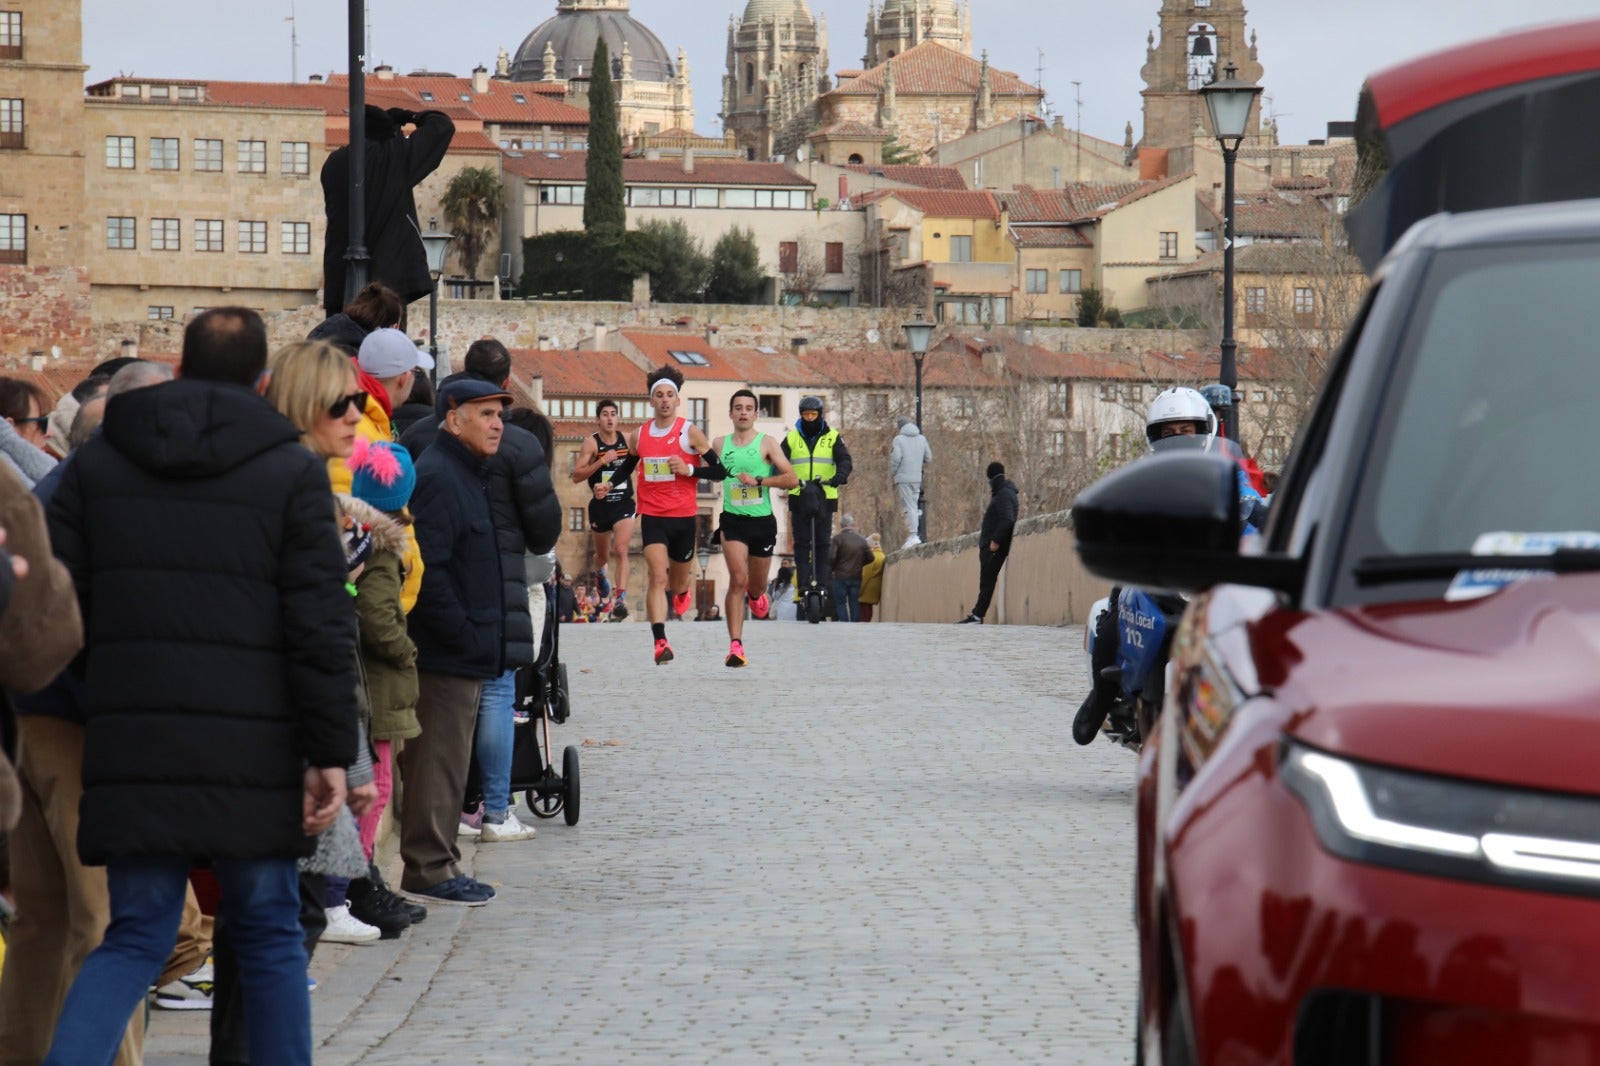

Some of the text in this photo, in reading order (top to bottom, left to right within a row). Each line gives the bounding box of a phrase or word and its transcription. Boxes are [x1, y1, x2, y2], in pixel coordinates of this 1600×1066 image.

[653, 463, 659, 474] 3
[741, 488, 748, 499] 5
[1136, 611, 1155, 630] Local
[1125, 626, 1145, 649] 112
